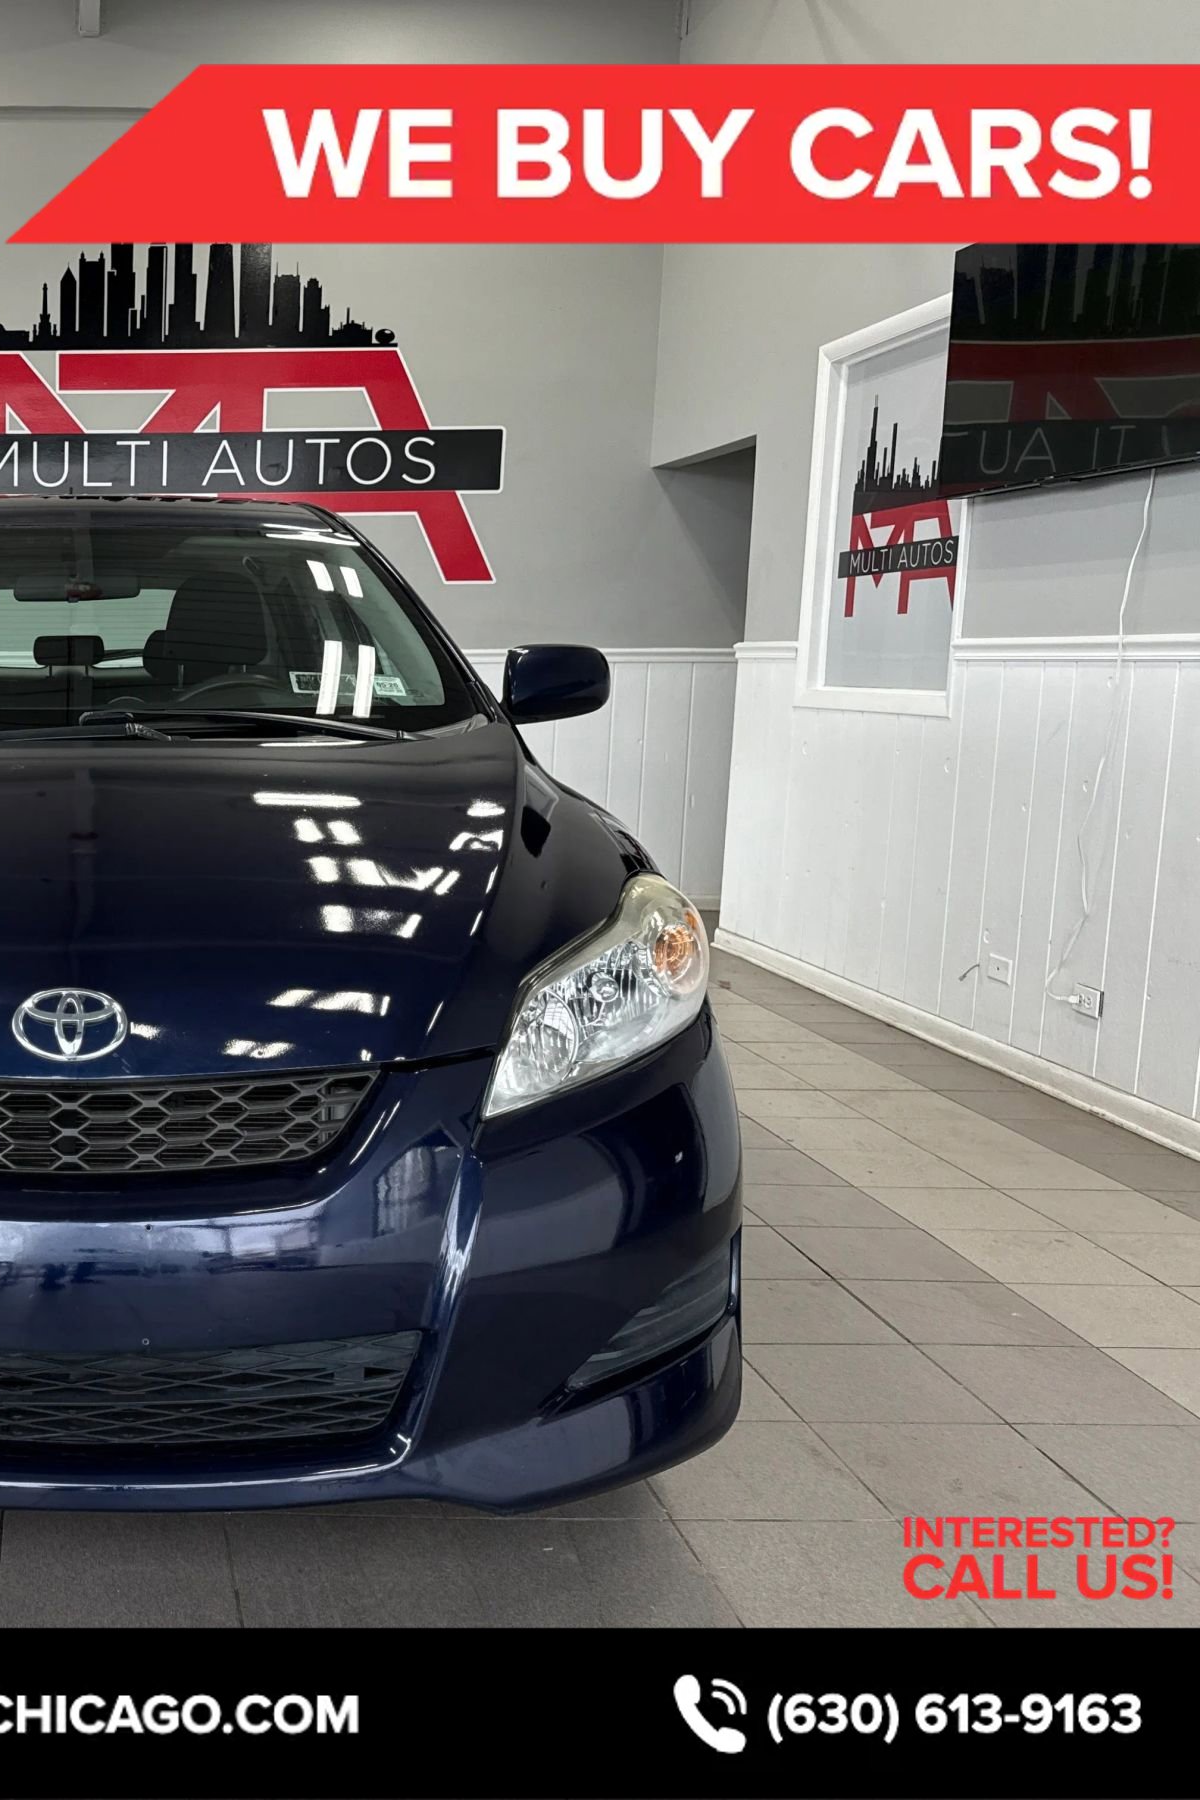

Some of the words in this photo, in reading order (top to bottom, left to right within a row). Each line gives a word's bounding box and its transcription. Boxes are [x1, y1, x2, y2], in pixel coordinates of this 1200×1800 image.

[202, 437, 436, 486] AUTOS
[849, 548, 893, 575] MULTI
[897, 540, 954, 569] AUTOS
